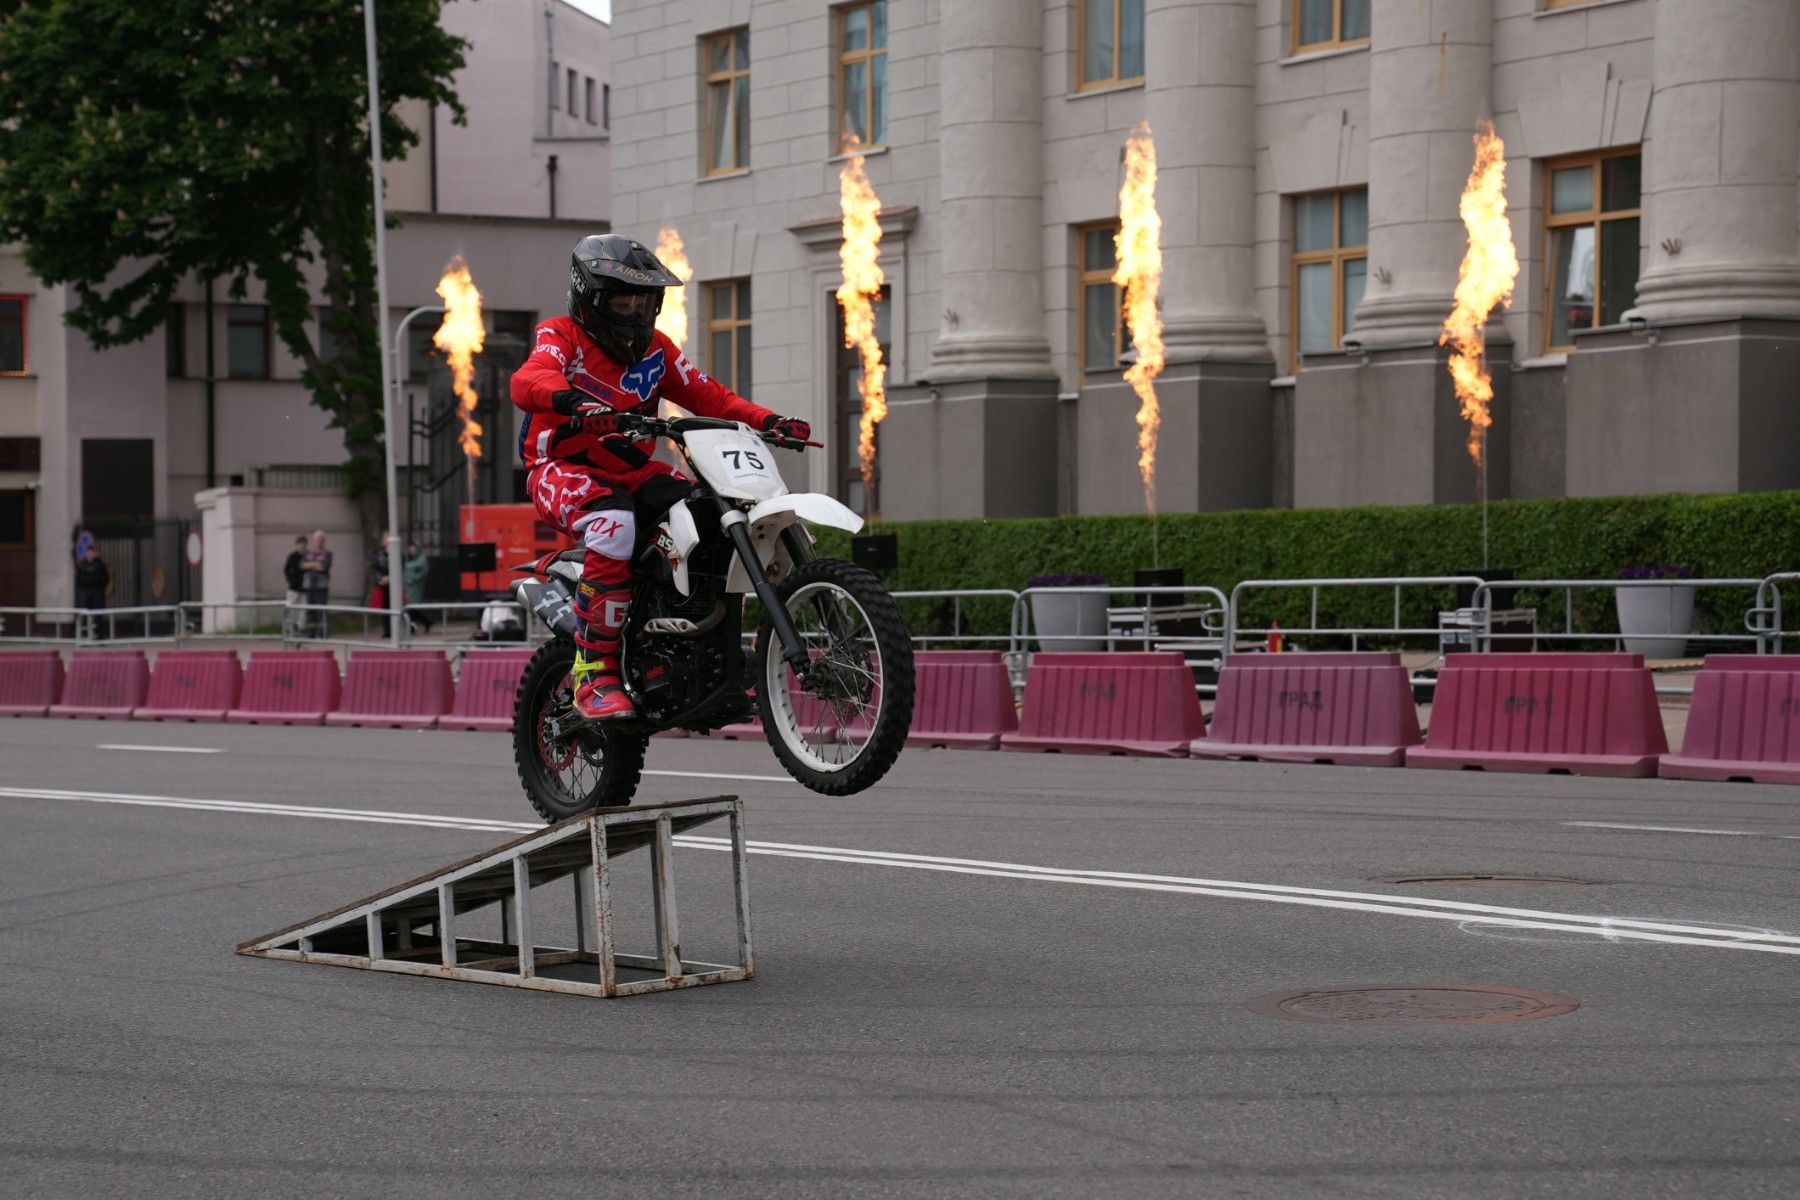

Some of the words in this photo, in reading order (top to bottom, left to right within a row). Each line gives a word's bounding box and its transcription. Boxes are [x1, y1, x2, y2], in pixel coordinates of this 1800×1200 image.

[586, 406, 612, 416] FOX
[723, 450, 765, 470] 75
[591, 517, 624, 538] OX
